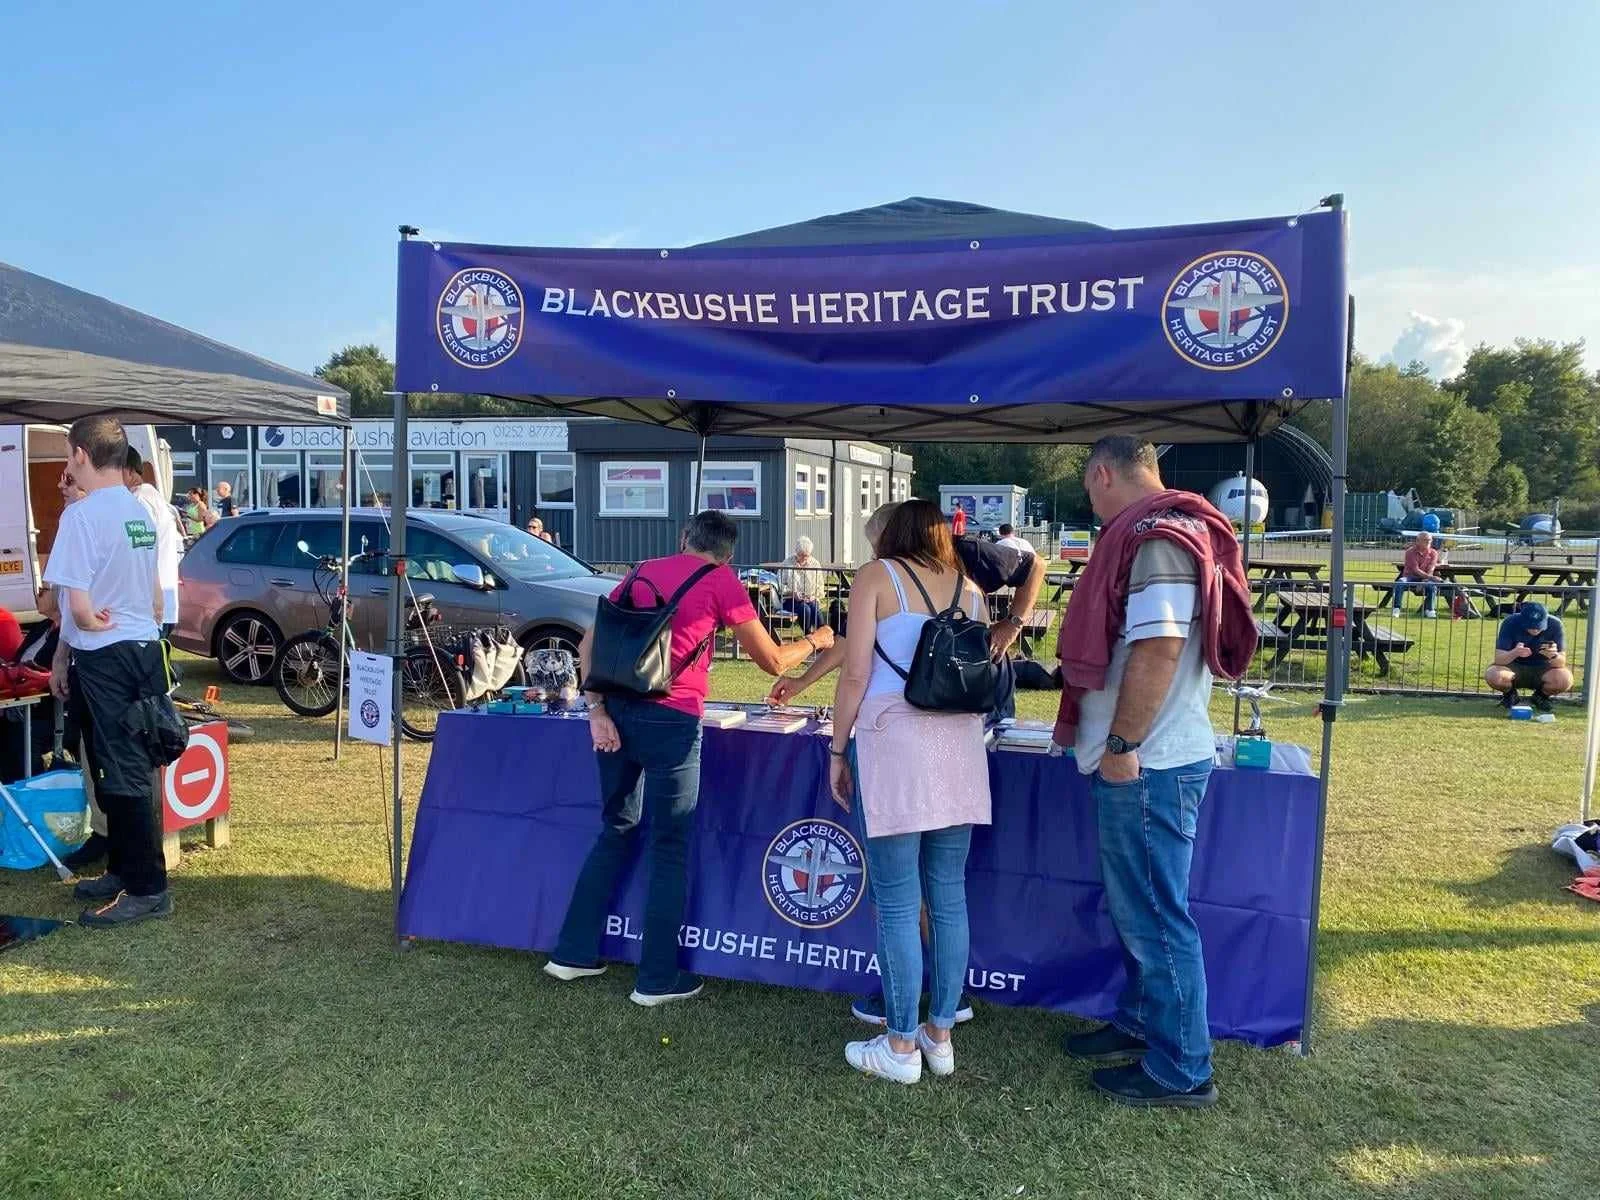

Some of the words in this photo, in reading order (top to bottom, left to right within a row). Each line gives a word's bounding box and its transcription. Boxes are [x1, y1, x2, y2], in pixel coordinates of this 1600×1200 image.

[445, 272, 517, 305] BLACKBUSHE
[1175, 257, 1278, 297] BLACKBUSHE
[540, 287, 778, 324] BLACKBUSHE
[790, 286, 990, 324] HERITAGE
[1003, 275, 1144, 316] TRUST
[443, 323, 488, 362] HERITAGE
[489, 324, 517, 359] TRUST
[1171, 318, 1235, 362] HERITAGE
[1237, 316, 1278, 358] TRUST
[410, 426, 486, 446] aviation
[775, 824, 858, 864] BLACKBUSHE
[769, 874, 818, 921] HERITAGE
[821, 884, 857, 919] TRUST
[606, 914, 777, 960] BLBUSHE
[785, 940, 882, 976] HERITA
[967, 968, 1026, 992] UST
